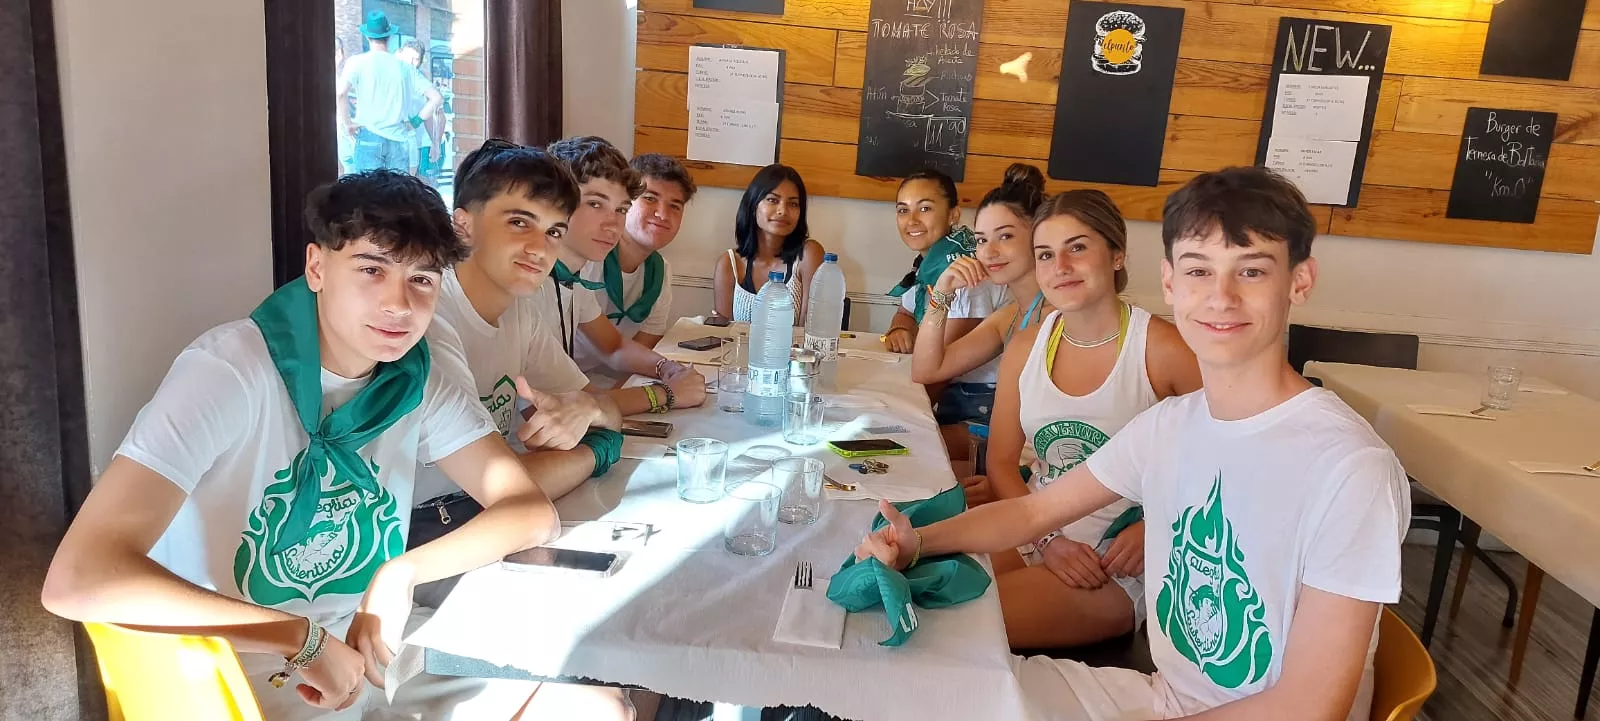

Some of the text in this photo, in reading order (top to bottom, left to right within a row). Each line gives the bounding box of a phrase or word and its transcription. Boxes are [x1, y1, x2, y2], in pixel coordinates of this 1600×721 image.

[871, 19, 979, 40] TOMATE ROSA
[1282, 24, 1375, 72] NEW...
[1486, 111, 1541, 142] Burger de
